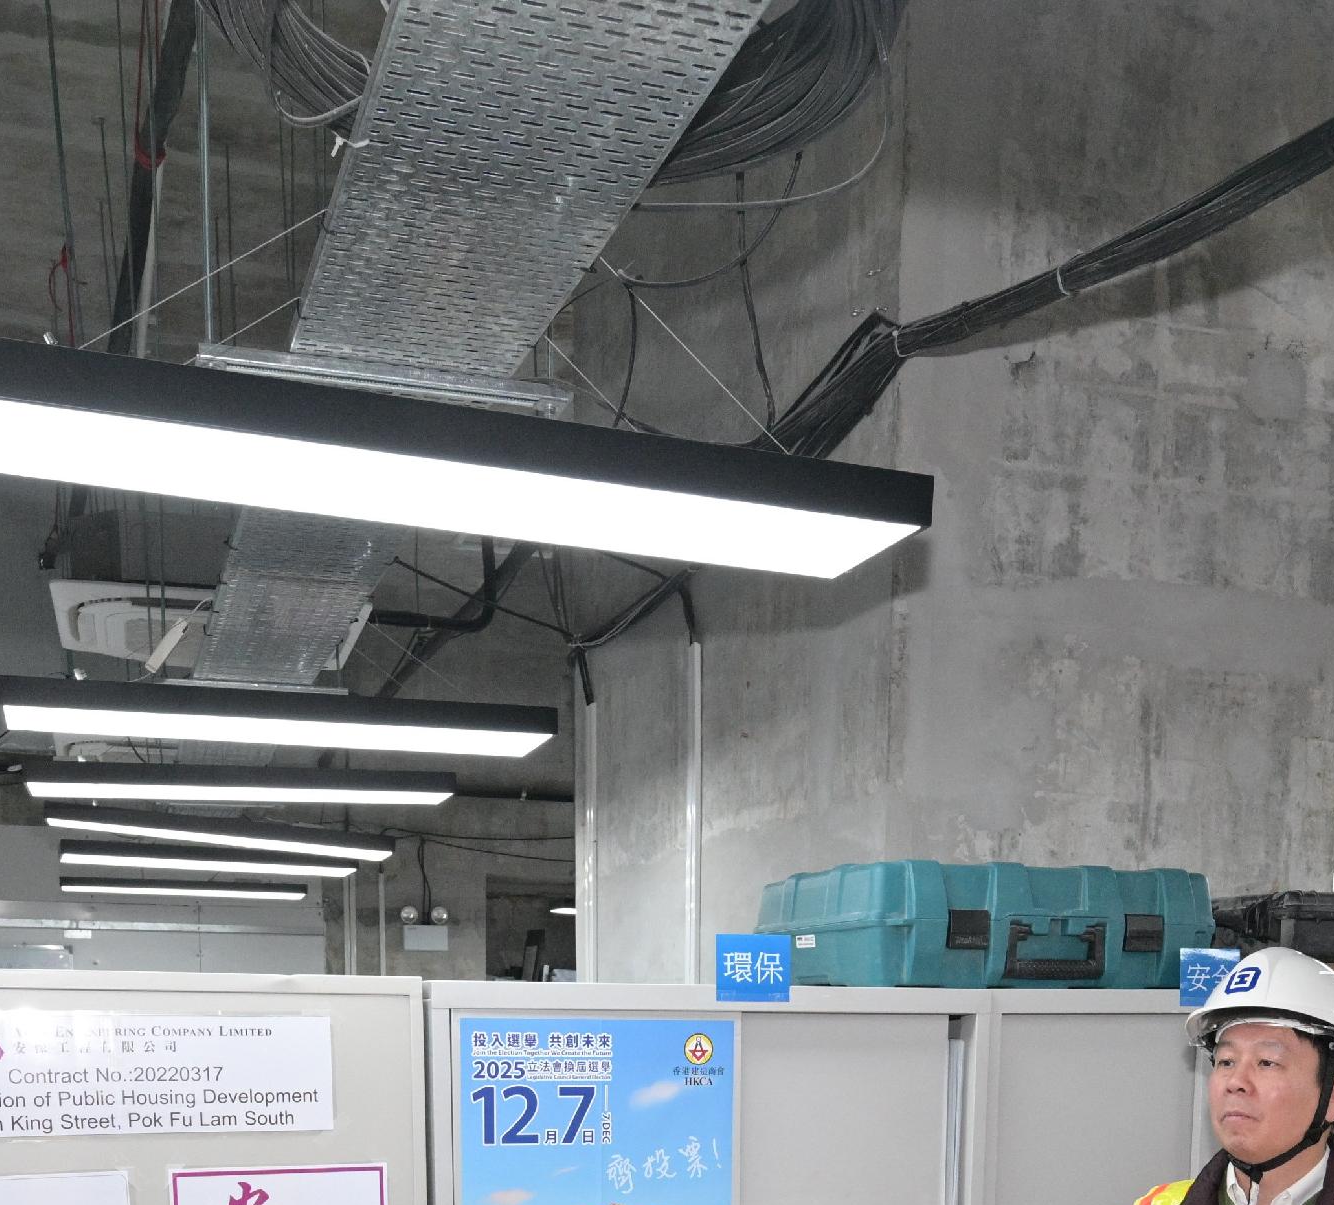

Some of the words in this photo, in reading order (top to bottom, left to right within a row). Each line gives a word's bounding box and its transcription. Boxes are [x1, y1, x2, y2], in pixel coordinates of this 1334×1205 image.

[723, 952, 783, 985] 環保
[219, 1025, 272, 1037] LIMITED
[473, 1033, 537, 1048] 投入選舉
[549, 1034, 611, 1048] 共創未來
[8, 1067, 88, 1084] Contract
[96, 1066, 223, 1082] No.:20220317
[473, 1061, 525, 1079] 2025
[685, 1077, 713, 1086] HKCA
[33, 1091, 52, 1107] of
[58, 1090, 115, 1107] Public
[121, 1089, 196, 1109] Housing
[203, 1088, 318, 1108] Development
[11, 1115, 53, 1135] King
[61, 1113, 121, 1131] Street,
[128, 1112, 163, 1128] Pok
[170, 1112, 192, 1128] Fu
[199, 1111, 237, 1127] Lam
[245, 1110, 295, 1126] South
[602, 1122, 611, 1143] DEC
